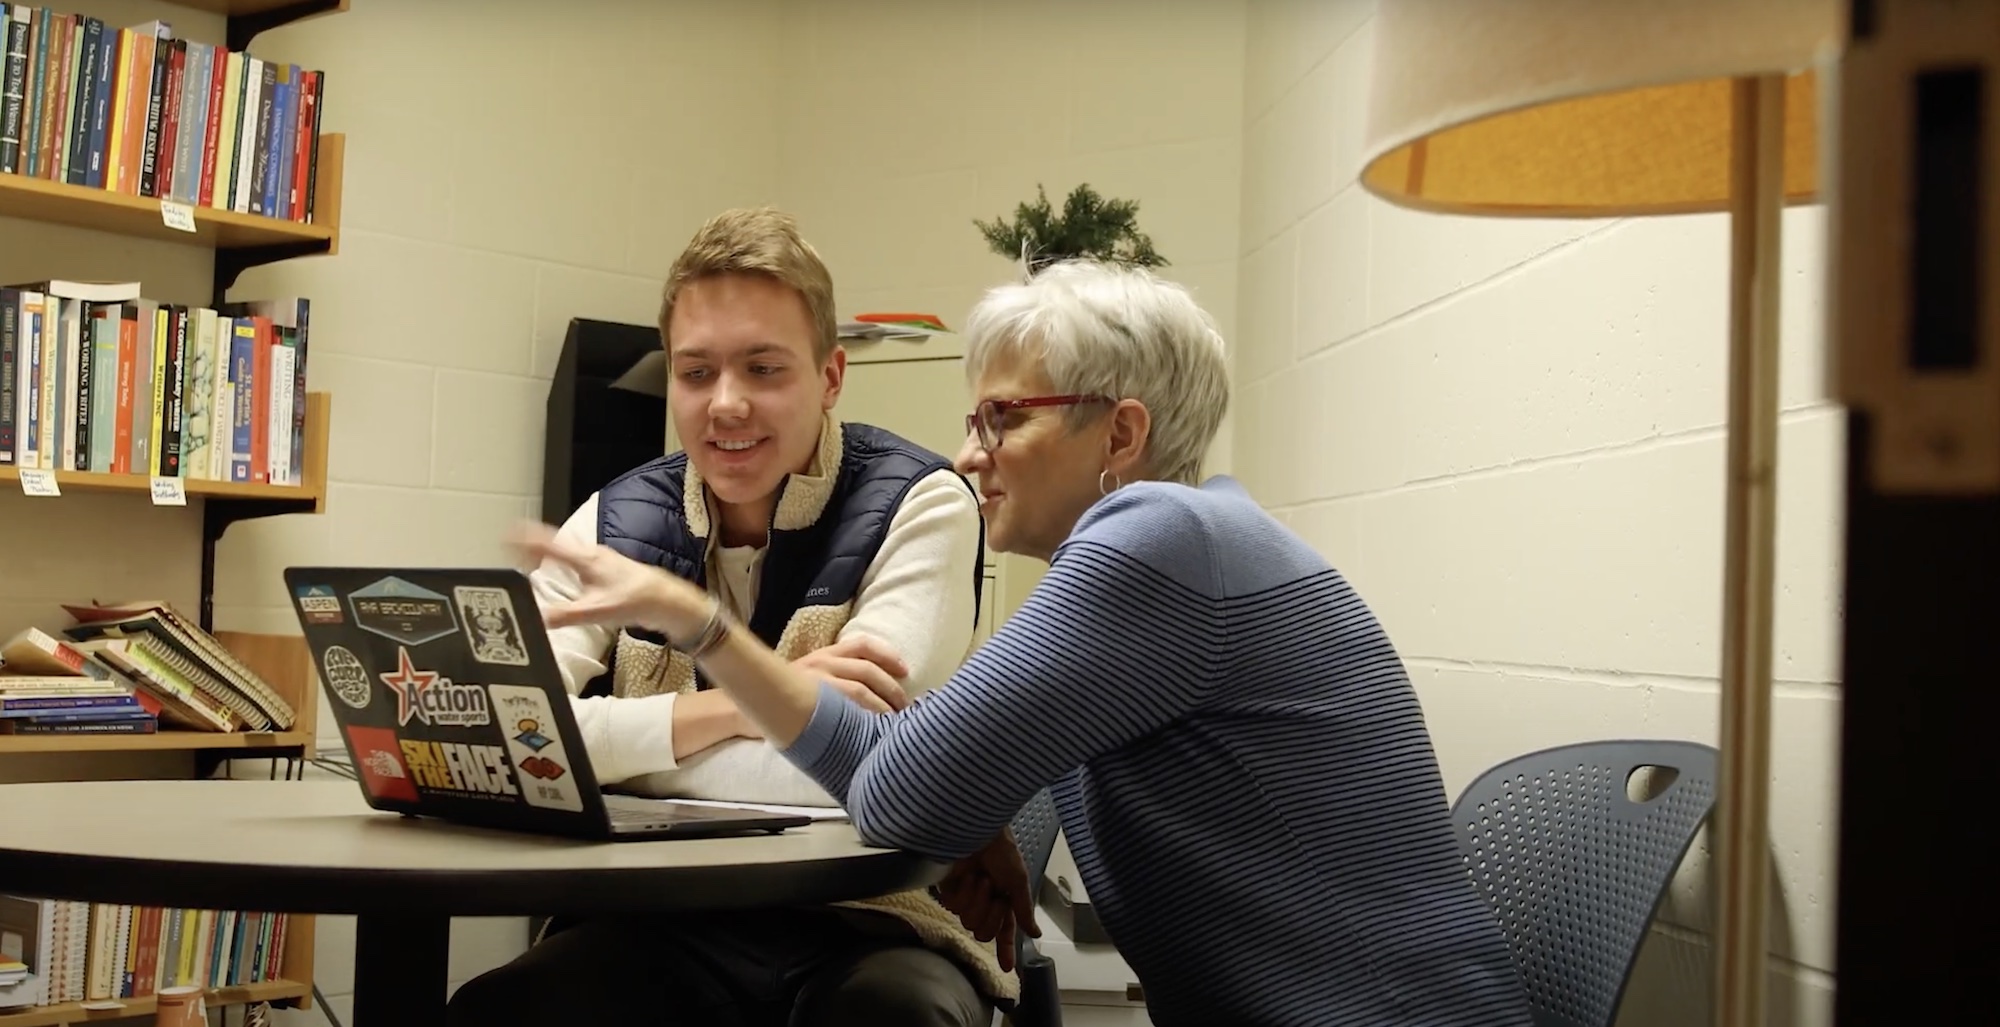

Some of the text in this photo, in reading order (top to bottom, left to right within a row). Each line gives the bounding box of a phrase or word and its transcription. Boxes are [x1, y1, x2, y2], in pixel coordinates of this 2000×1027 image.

[12, 64, 21, 75] TO
[187, 51, 199, 90] TEACHING
[7, 102, 19, 135] WRITING
[148, 94, 161, 130] WRITING
[183, 92, 195, 133] STUDENTS
[259, 99, 271, 138] Dialogue
[143, 131, 157, 173] RESEARCH
[179, 147, 188, 173] WRITE
[253, 149, 269, 193] Writing
[45, 349, 54, 381] Writing
[80, 340, 90, 385] WORKING
[156, 364, 164, 397] Writers
[171, 311, 186, 432] THE CONTEMPORARY WRITER
[283, 349, 293, 398] WRITING
[45, 384, 53, 420] Portfolio
[120, 361, 129, 407] Writing Today
[237, 384, 243, 392] to
[78, 387, 87, 425] WRITER
[235, 394, 243, 427] Writing
[243, 388, 251, 425] Martin's
[303, 598, 338, 610] ASPEN
[406, 682, 486, 722] Action
[437, 712, 487, 724] water sports
[399, 739, 446, 766] SKI
[440, 742, 519, 795] FACE
[409, 764, 455, 789] THE
